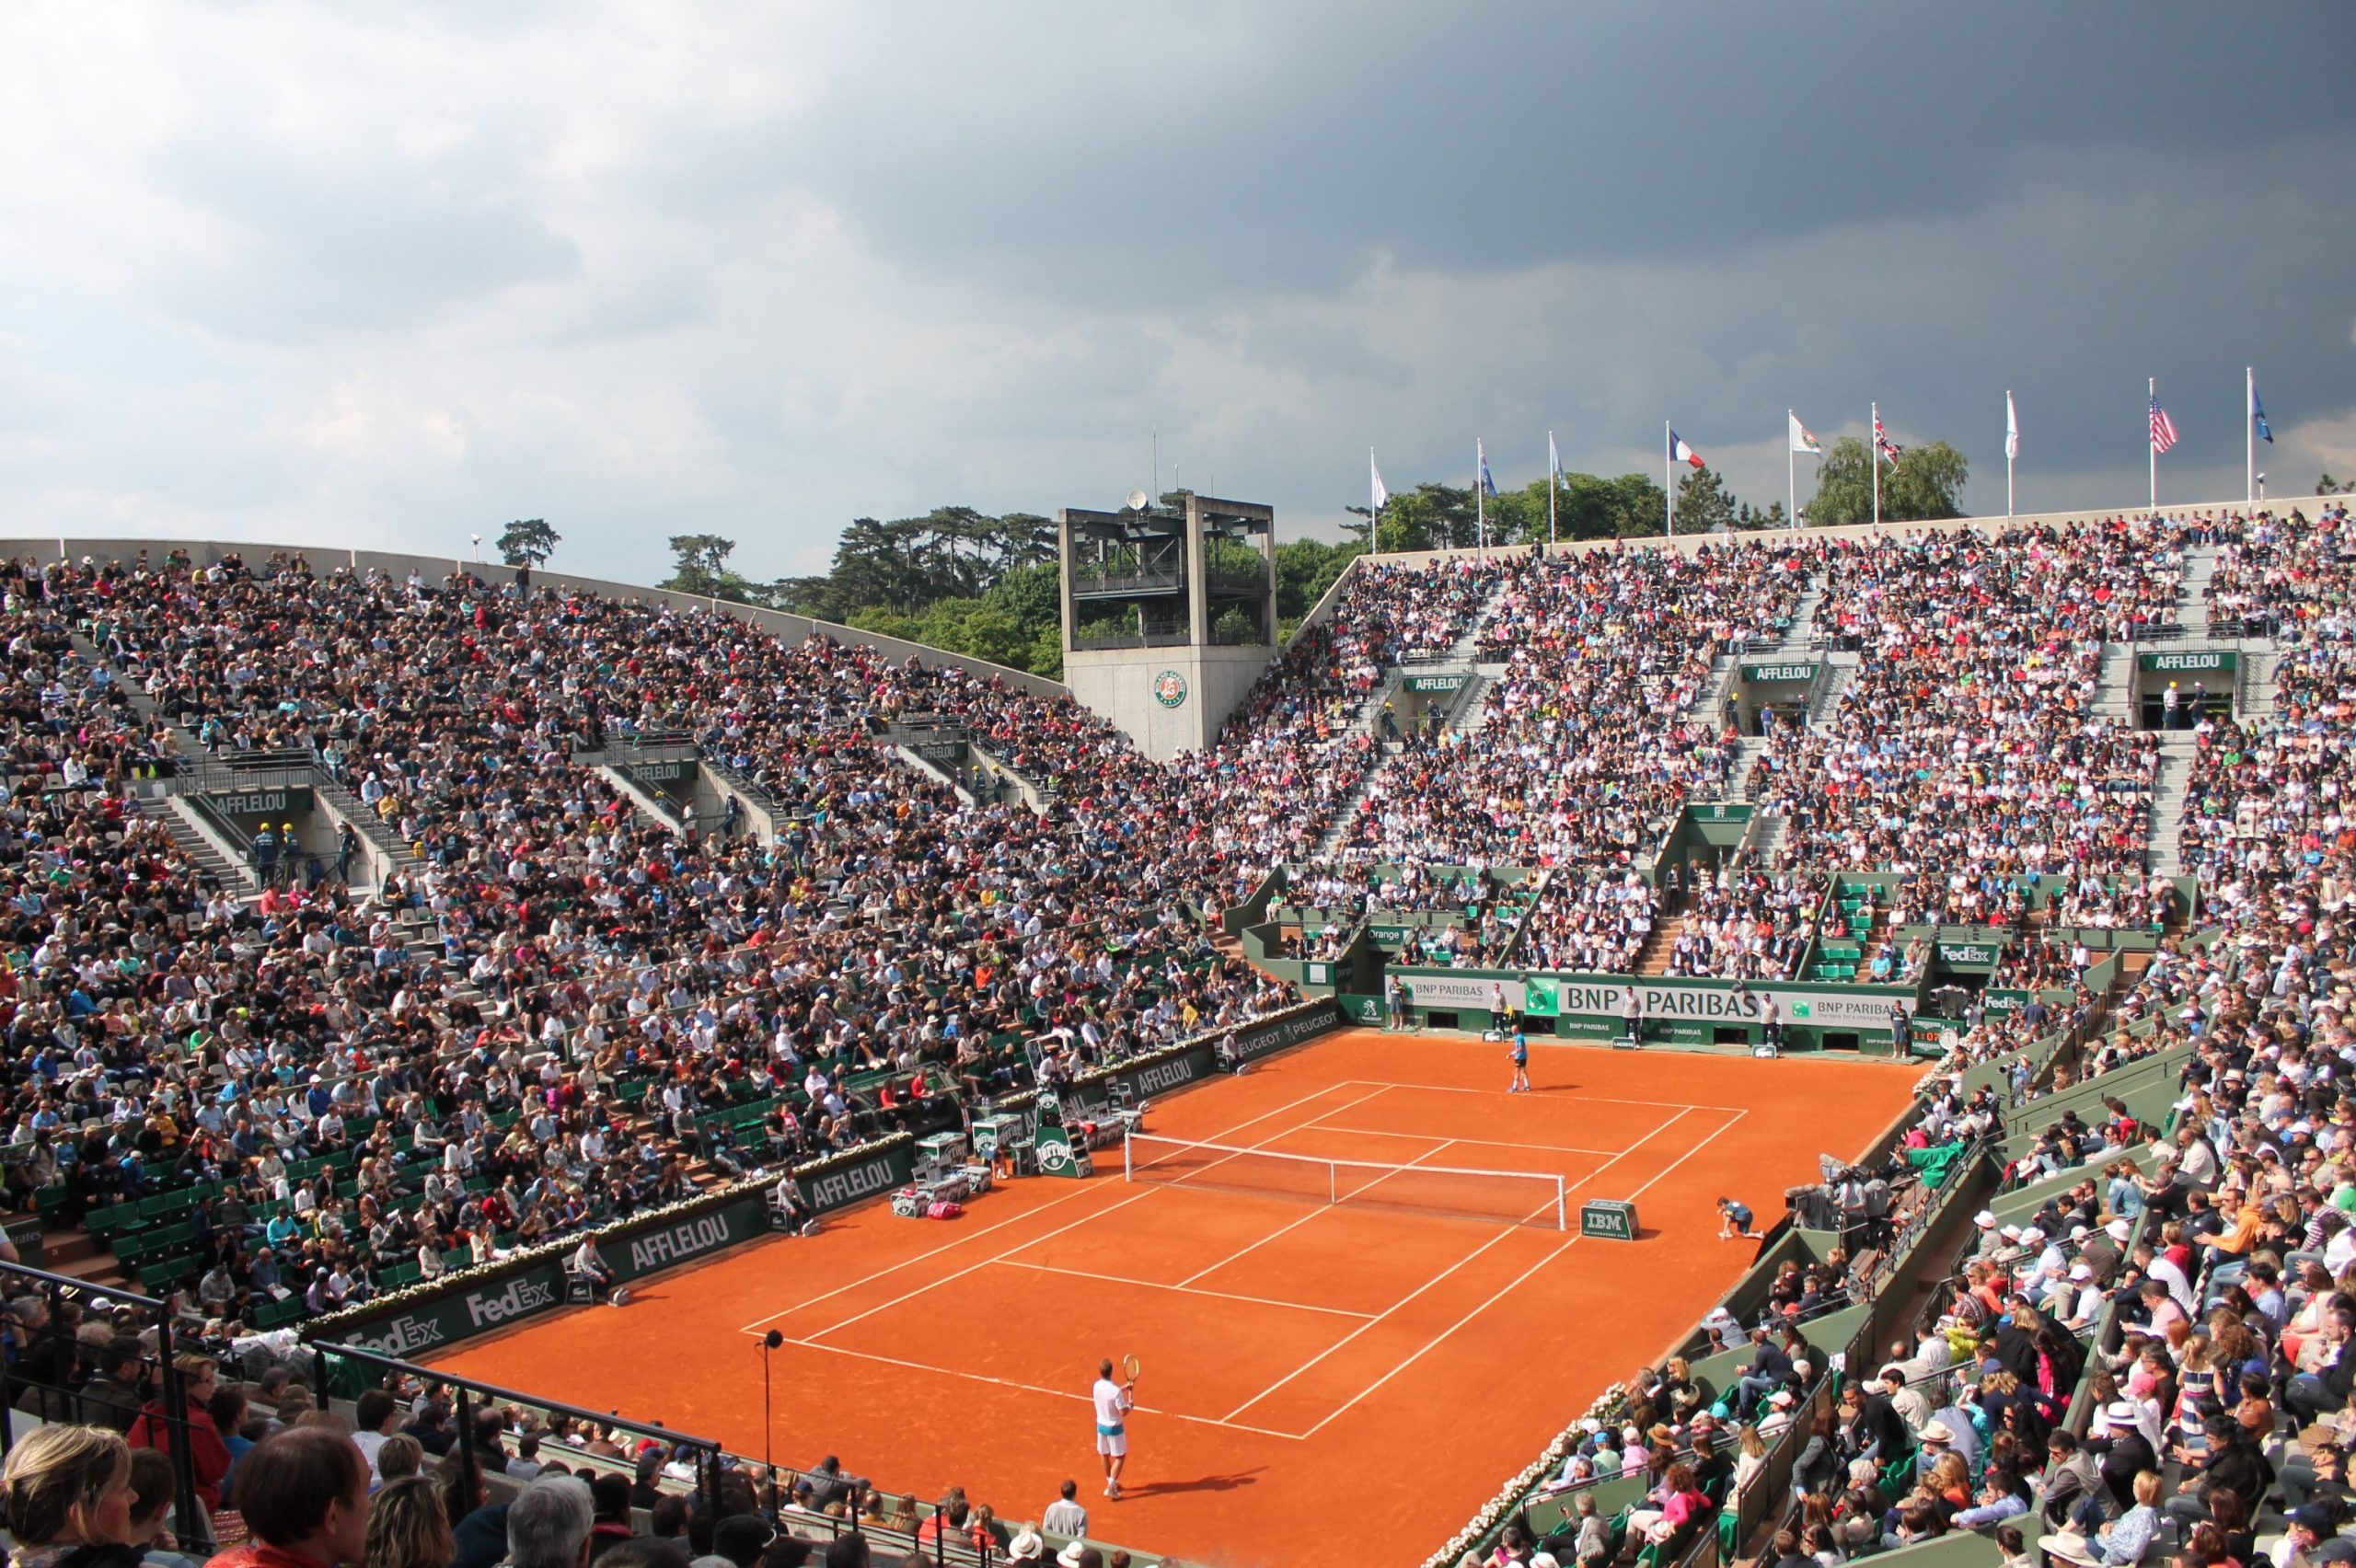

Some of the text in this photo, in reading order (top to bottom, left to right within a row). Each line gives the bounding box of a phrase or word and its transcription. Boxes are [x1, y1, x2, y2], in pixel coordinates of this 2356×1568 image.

[2155, 654, 2220, 669] AFFLELOU
[1757, 666, 1810, 680] AFFLELOU
[1415, 677, 1461, 690] AFFLELOU
[632, 765, 679, 780] AFFLELOU
[216, 793, 286, 814] AFFLELOU
[1369, 929, 1399, 940] Orange
[1940, 945, 1990, 963] FedEx
[1415, 984, 1484, 997] BNP PARIBAS
[1568, 987, 1760, 1018] BNP PARIBAS
[1818, 1002, 1842, 1013] BNP
[1293, 1013, 1337, 1036] PEUGEOT
[1583, 1023, 1610, 1032] PARIBAS
[1238, 1031, 1280, 1055] EUGEOT
[1138, 1059, 1193, 1095] AFFLELOU
[812, 1159, 895, 1209] AFFLELOU
[1588, 1213, 1622, 1231] IBM
[630, 1214, 730, 1272] AFFLELOU
[466, 1278, 554, 1327] FedEx
